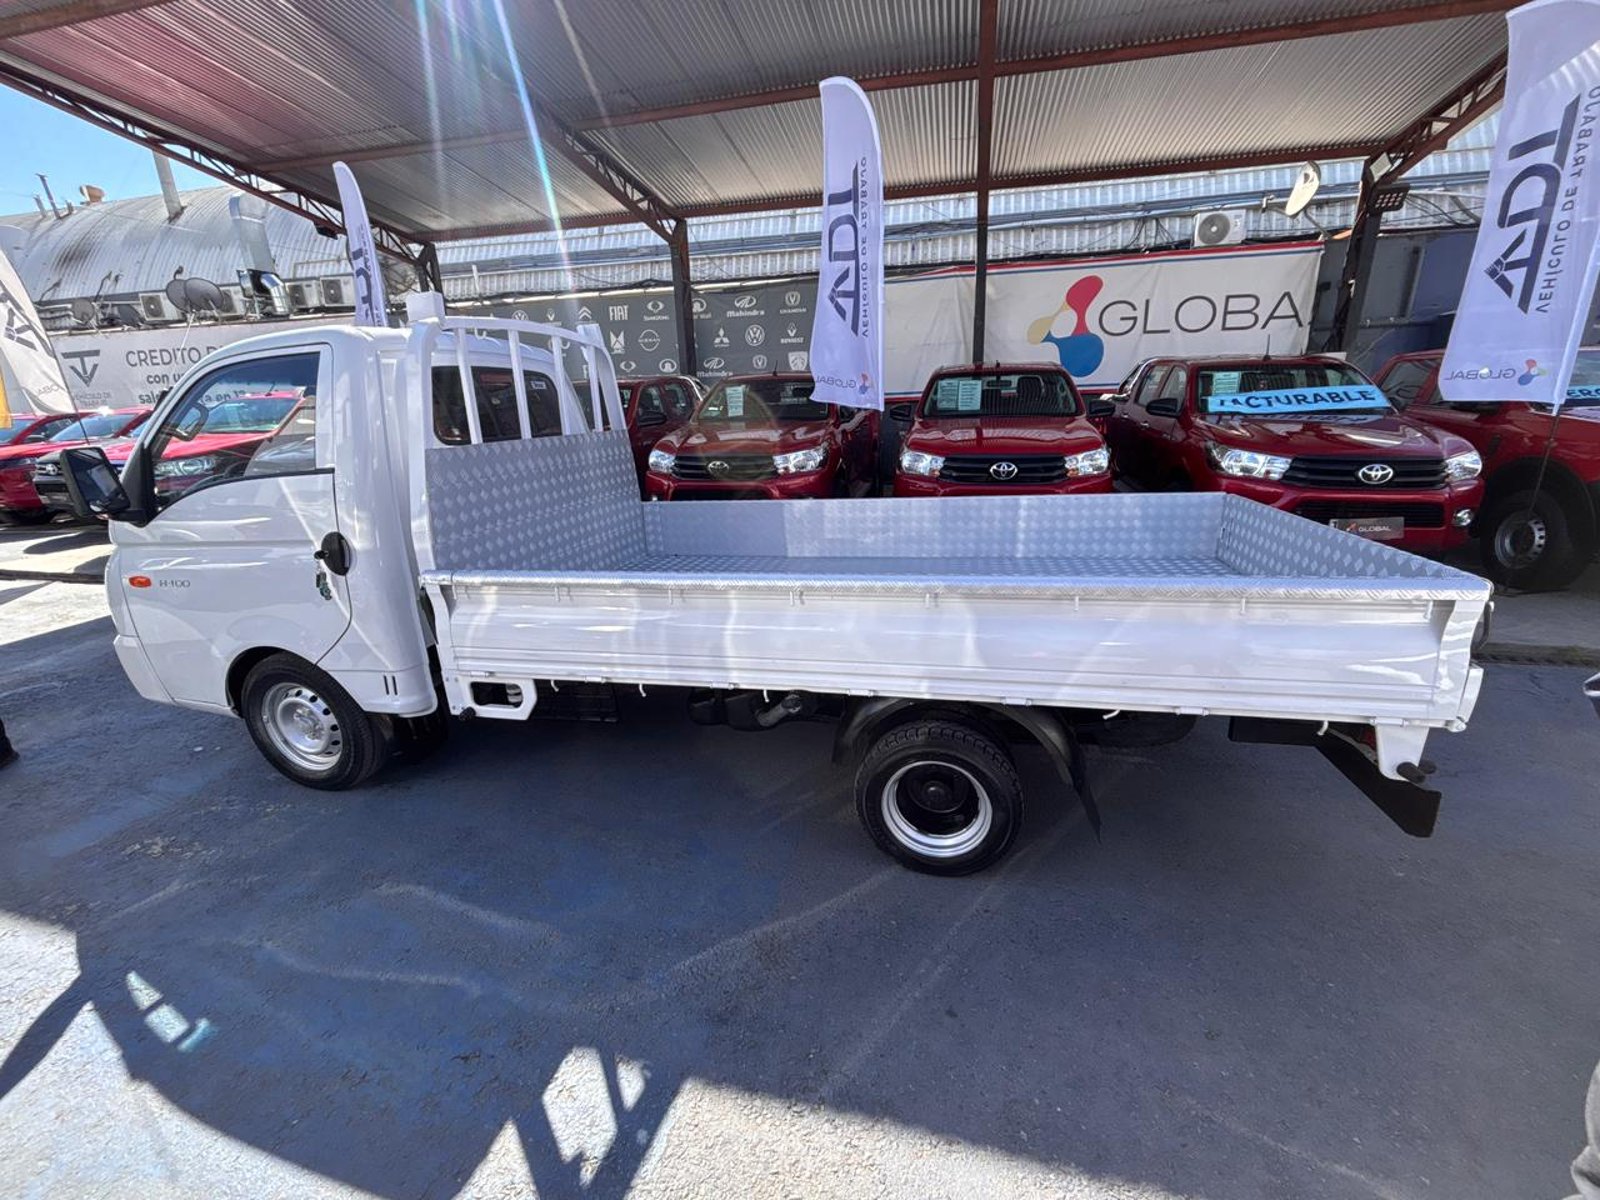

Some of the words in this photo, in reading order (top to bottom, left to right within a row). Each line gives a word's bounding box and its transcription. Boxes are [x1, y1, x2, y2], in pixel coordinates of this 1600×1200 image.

[608, 305, 629, 321] FIAT
[125, 347, 201, 367] CREDITO
[146, 373, 170, 385] con
